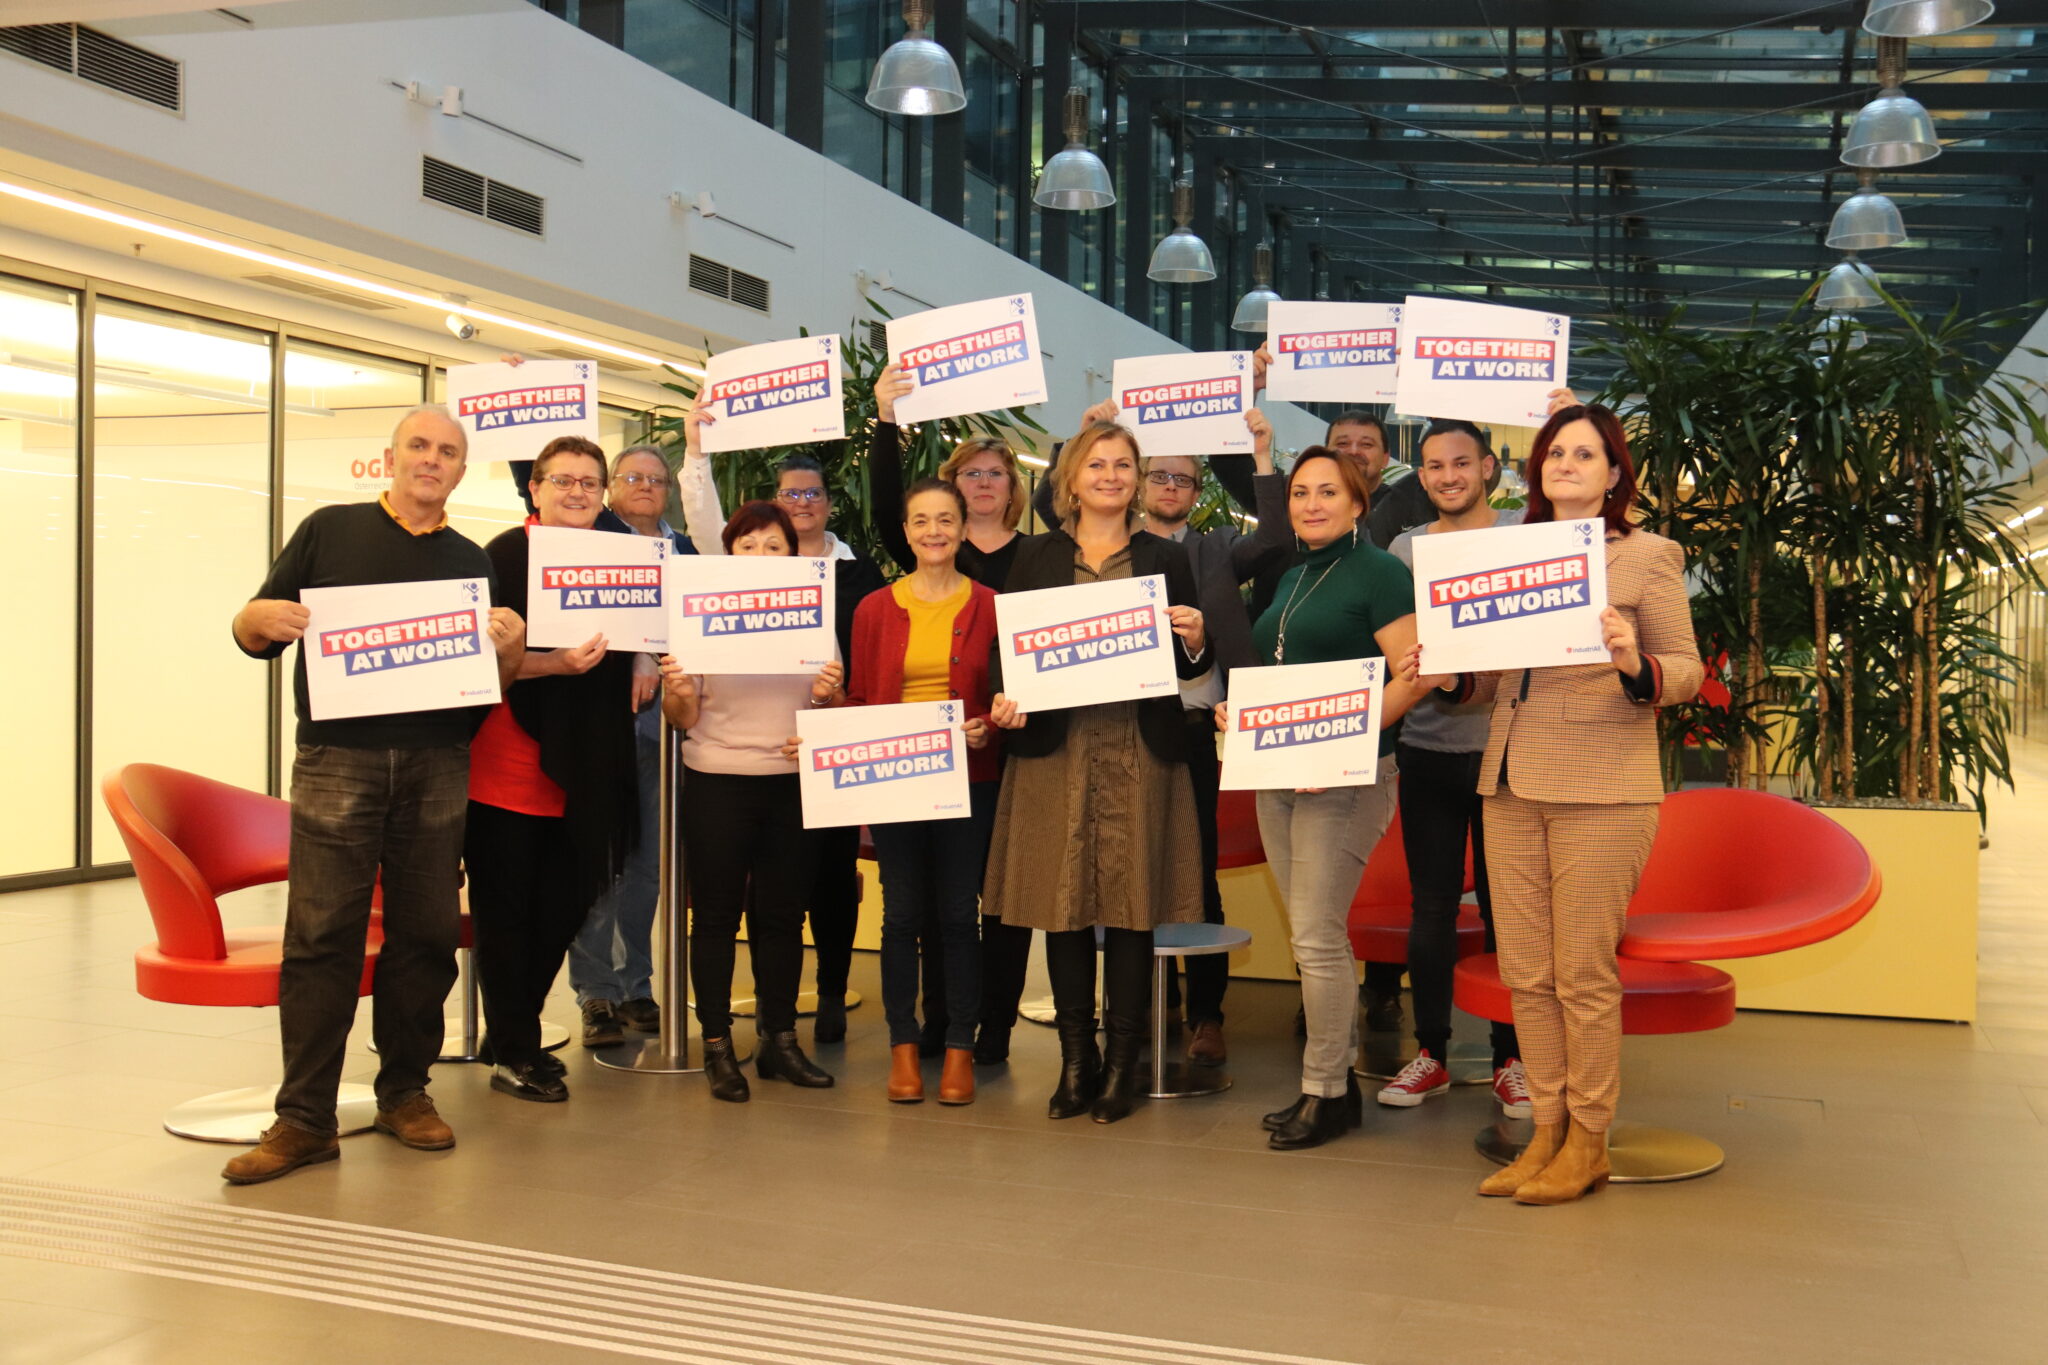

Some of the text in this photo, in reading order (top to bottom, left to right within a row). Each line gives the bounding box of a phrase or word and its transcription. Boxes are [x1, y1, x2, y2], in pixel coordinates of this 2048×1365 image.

[903, 325, 1020, 367] TOGETHER
[1282, 331, 1393, 350] TOGETHER
[1420, 339, 1552, 358] TOGETHER
[924, 344, 1024, 382] AT WORK
[1298, 348, 1393, 367] AT WORK
[1437, 361, 1549, 378] AT WORK
[715, 364, 826, 398] TOGETHER
[1126, 379, 1237, 405] TOGETHER
[463, 388, 581, 413] TOGETHER
[731, 382, 827, 414] AT WORK
[1143, 396, 1238, 421] AT WORK
[480, 404, 582, 428] AT WORK
[546, 568, 659, 586] TOGETHER
[1434, 559, 1583, 602] TOGETHER
[565, 588, 658, 606] AT WORK
[687, 589, 817, 613] TOGETHER
[1457, 583, 1584, 623] AT WORK
[326, 614, 473, 652] TOGETHER
[707, 609, 818, 633] AT WORK
[1018, 610, 1151, 651] TOGETHER
[351, 635, 475, 672] AT WORK
[1040, 630, 1154, 668] AT WORK
[1243, 692, 1366, 727] TOGETHER
[1259, 714, 1364, 747] AT WORK
[817, 733, 947, 767] TOGETHER
[839, 753, 949, 784] AT WORK
